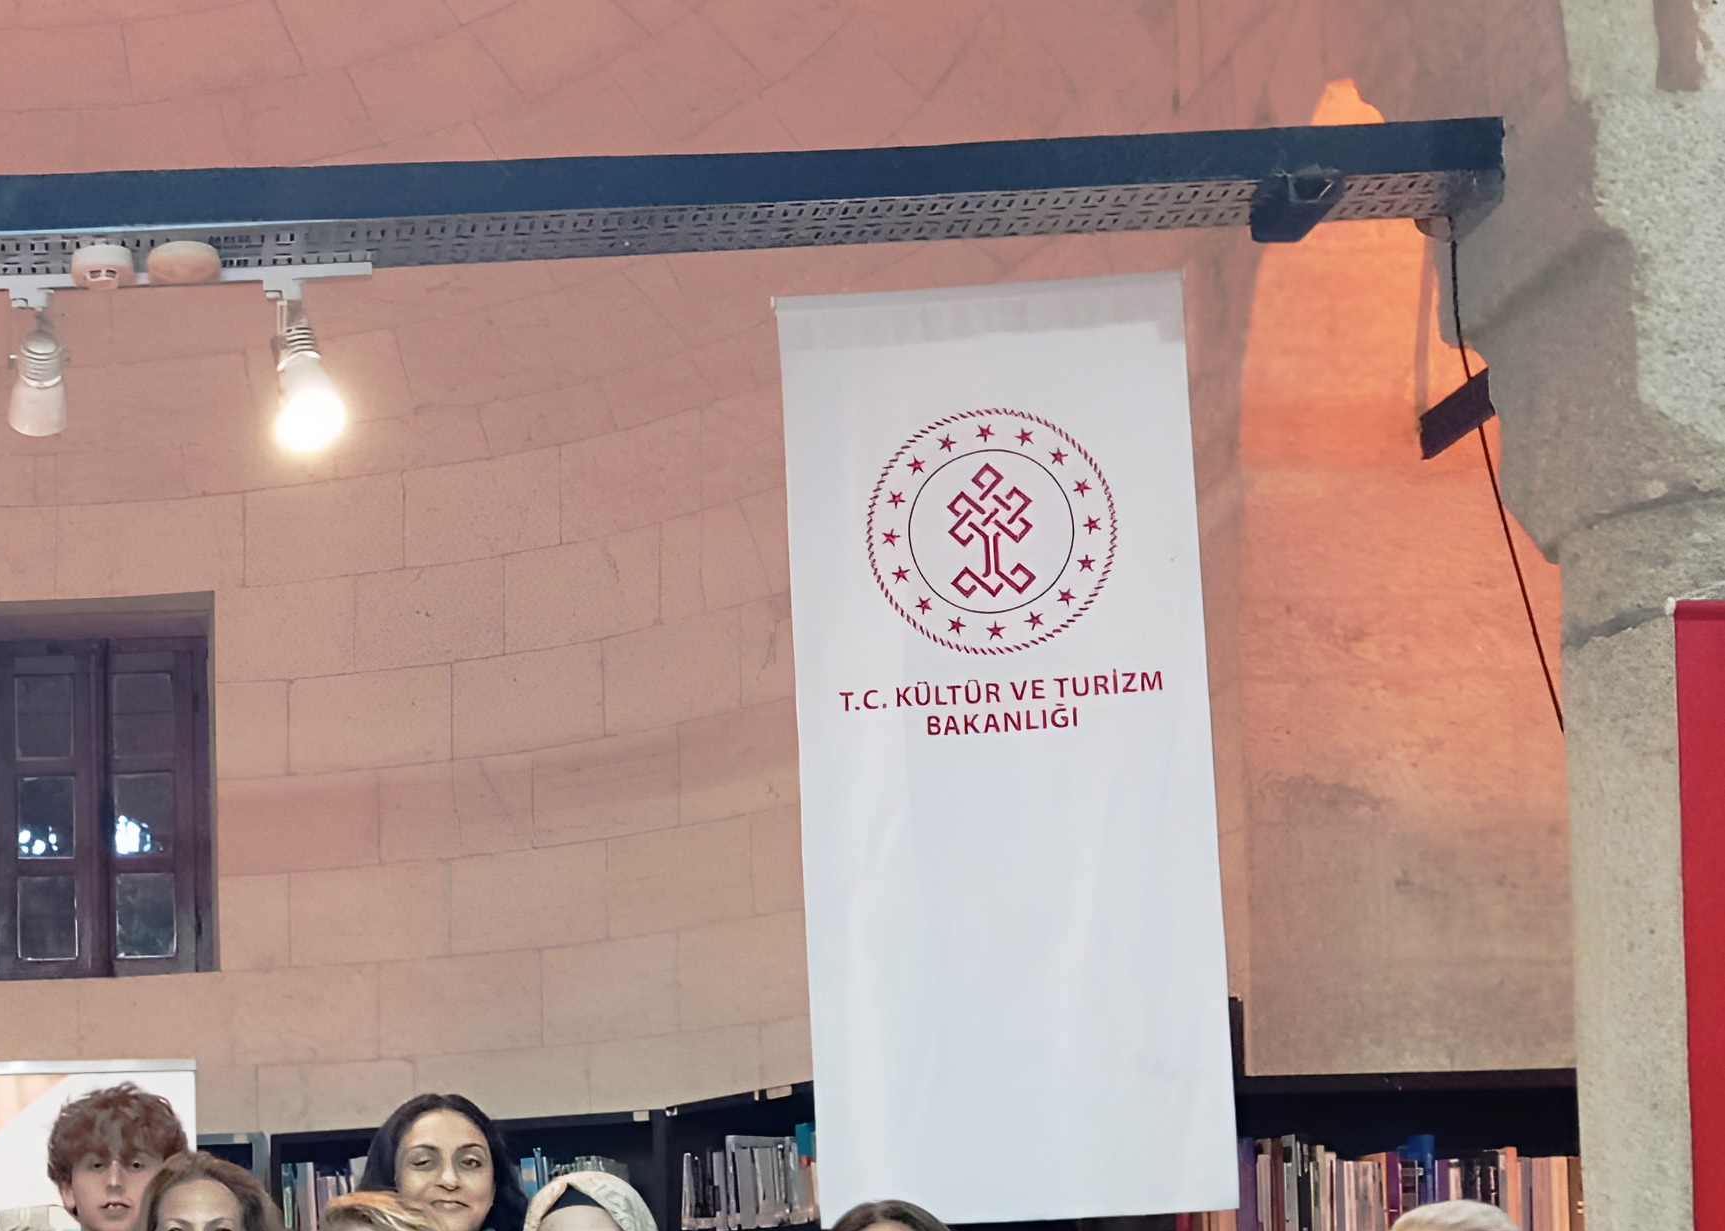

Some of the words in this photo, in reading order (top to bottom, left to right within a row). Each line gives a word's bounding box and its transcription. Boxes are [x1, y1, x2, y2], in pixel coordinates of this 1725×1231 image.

[838, 690, 888, 712] T.C.
[895, 679, 1001, 708] KÜLTÜR
[1009, 679, 1046, 701] VE
[1052, 667, 1163, 698] TURİZM
[926, 703, 1078, 736] BAKANLIĞI
